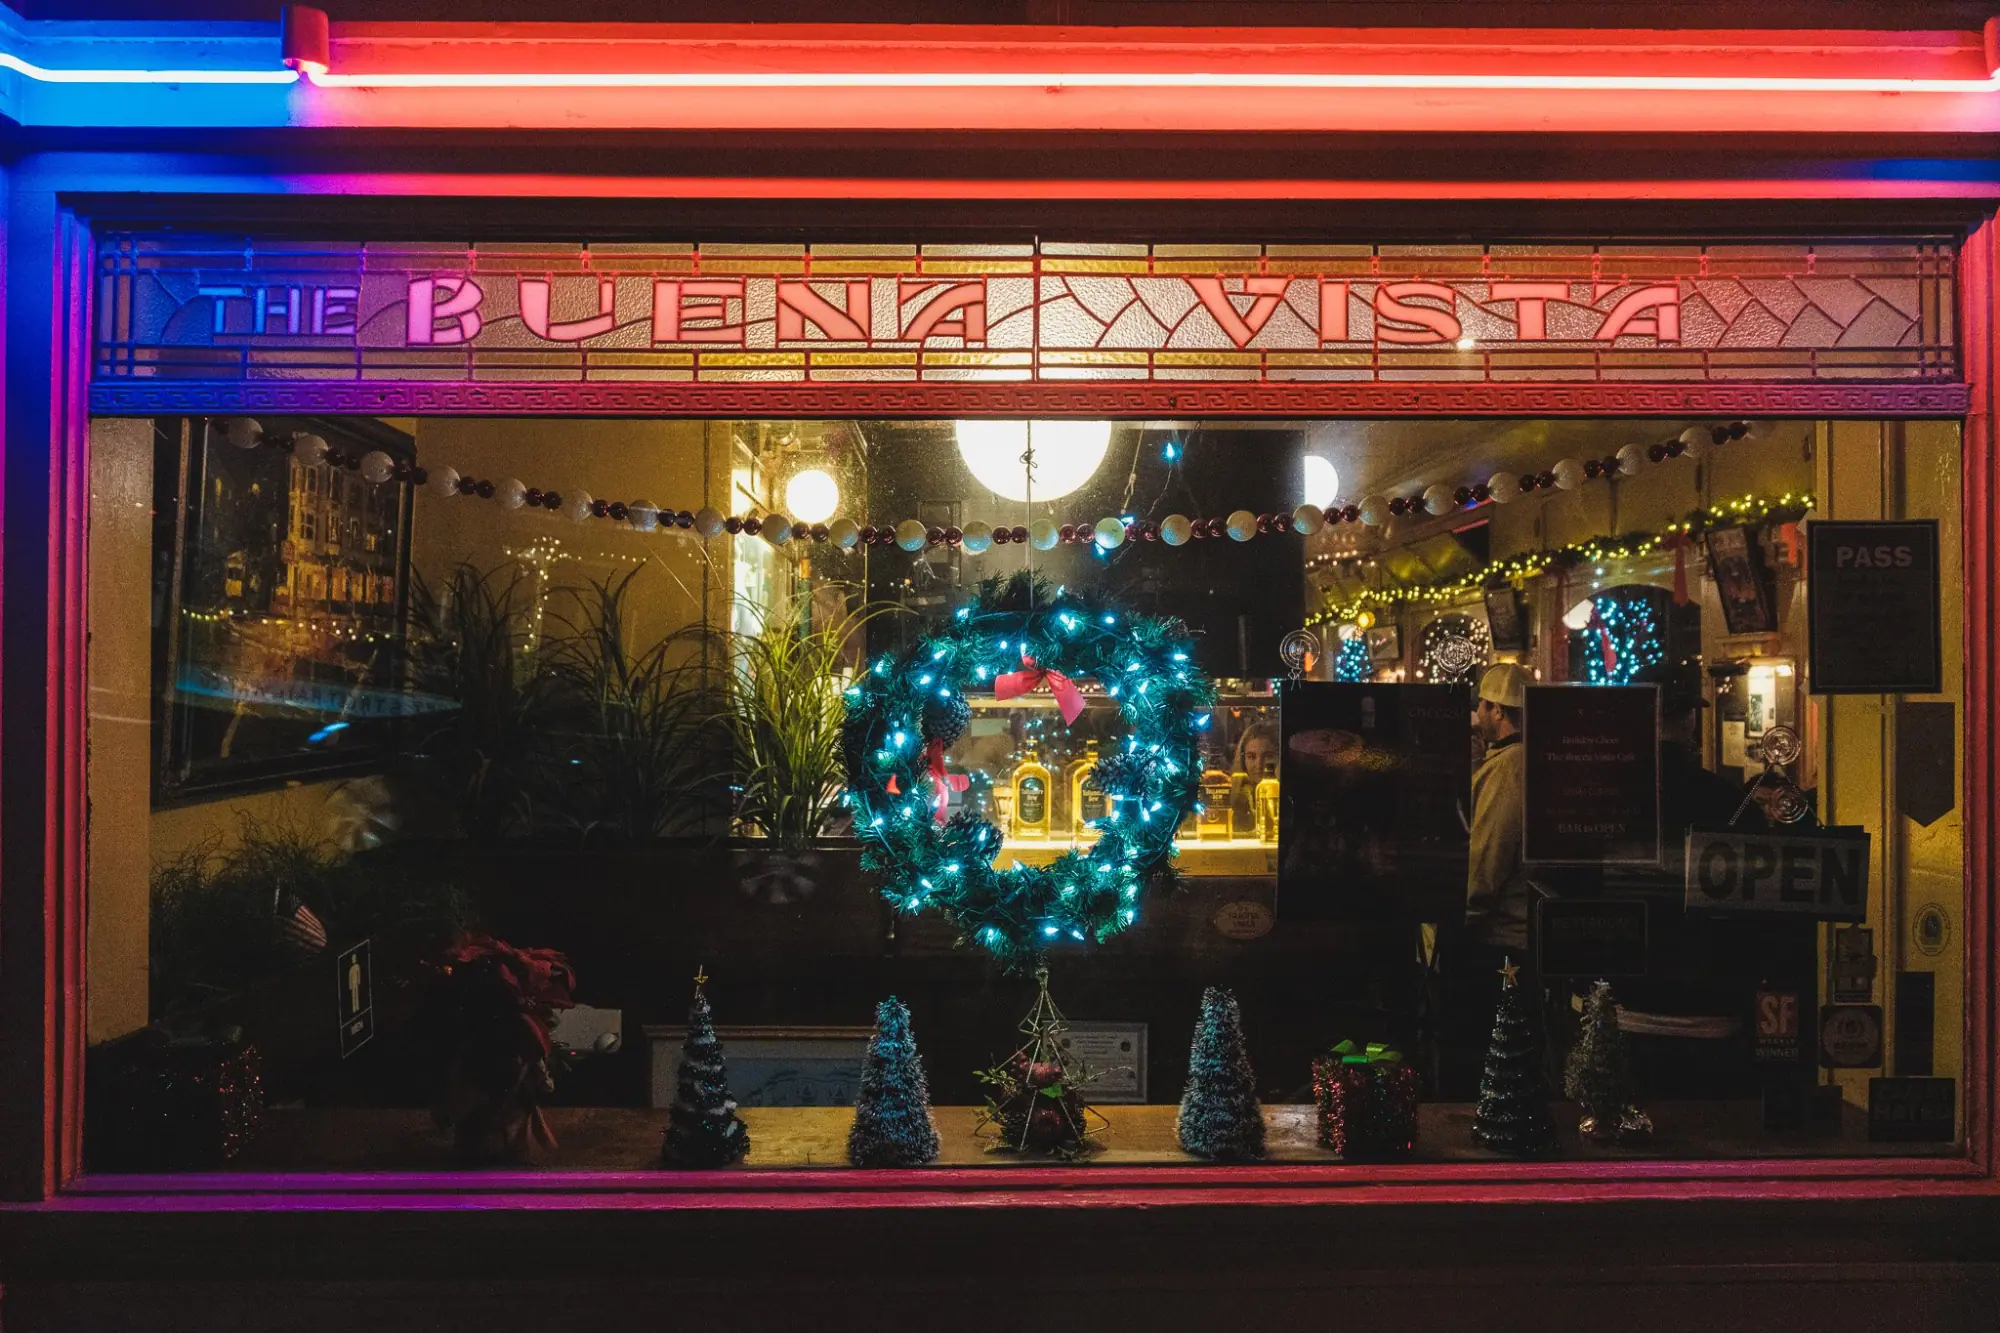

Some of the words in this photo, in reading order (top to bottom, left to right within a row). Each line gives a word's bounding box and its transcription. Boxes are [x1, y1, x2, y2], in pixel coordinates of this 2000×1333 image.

[200, 284, 358, 335] THE
[406, 276, 988, 346] BUENA
[1190, 276, 1683, 346] VISTA
[1836, 545, 1914, 568] PASS
[1698, 841, 1860, 906] OPEN
[1760, 995, 1795, 1034] SF
